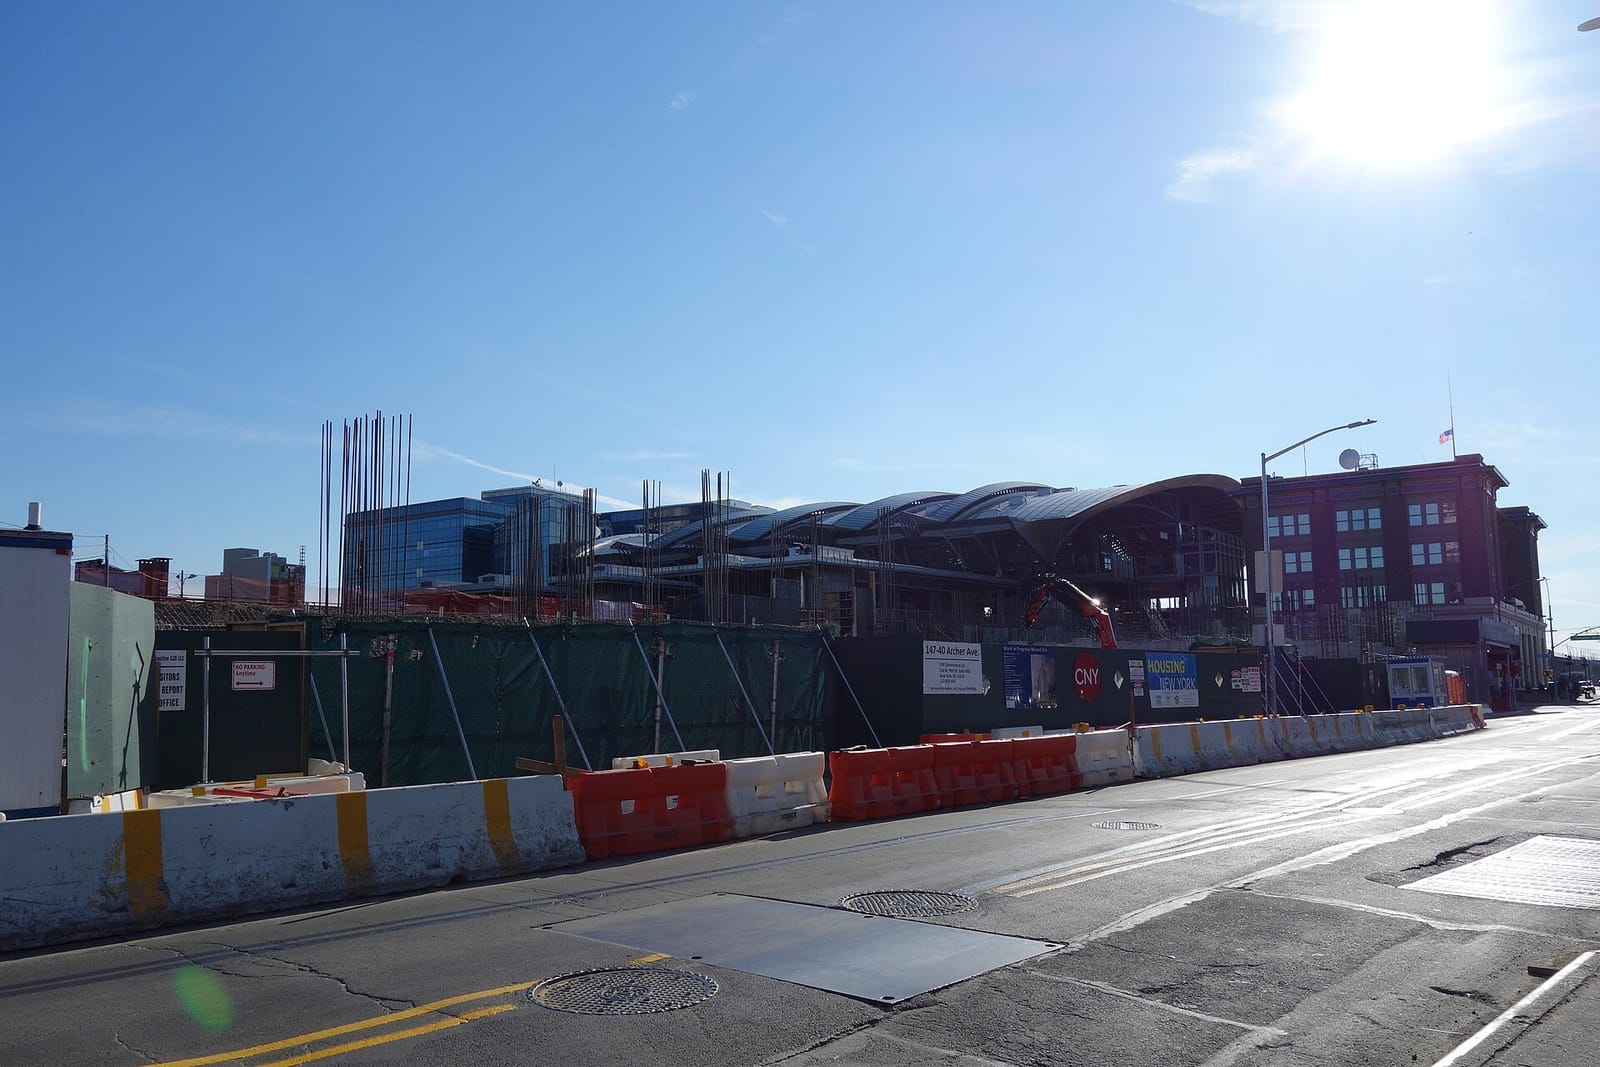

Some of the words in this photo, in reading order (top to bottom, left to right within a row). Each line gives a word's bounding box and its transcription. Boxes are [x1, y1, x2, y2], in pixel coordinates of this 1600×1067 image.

[926, 645, 946, 655] 147-40
[947, 646, 966, 656] Archer
[966, 647, 980, 656] Ave.
[1148, 659, 1185, 673] HOUSING
[160, 672, 180, 681] SITORS
[1074, 667, 1099, 685] CNY
[1160, 677, 1175, 690] NEW
[1177, 677, 1196, 690] YORK
[162, 685, 184, 694] REPORT
[159, 698, 180, 707] OFFICE
